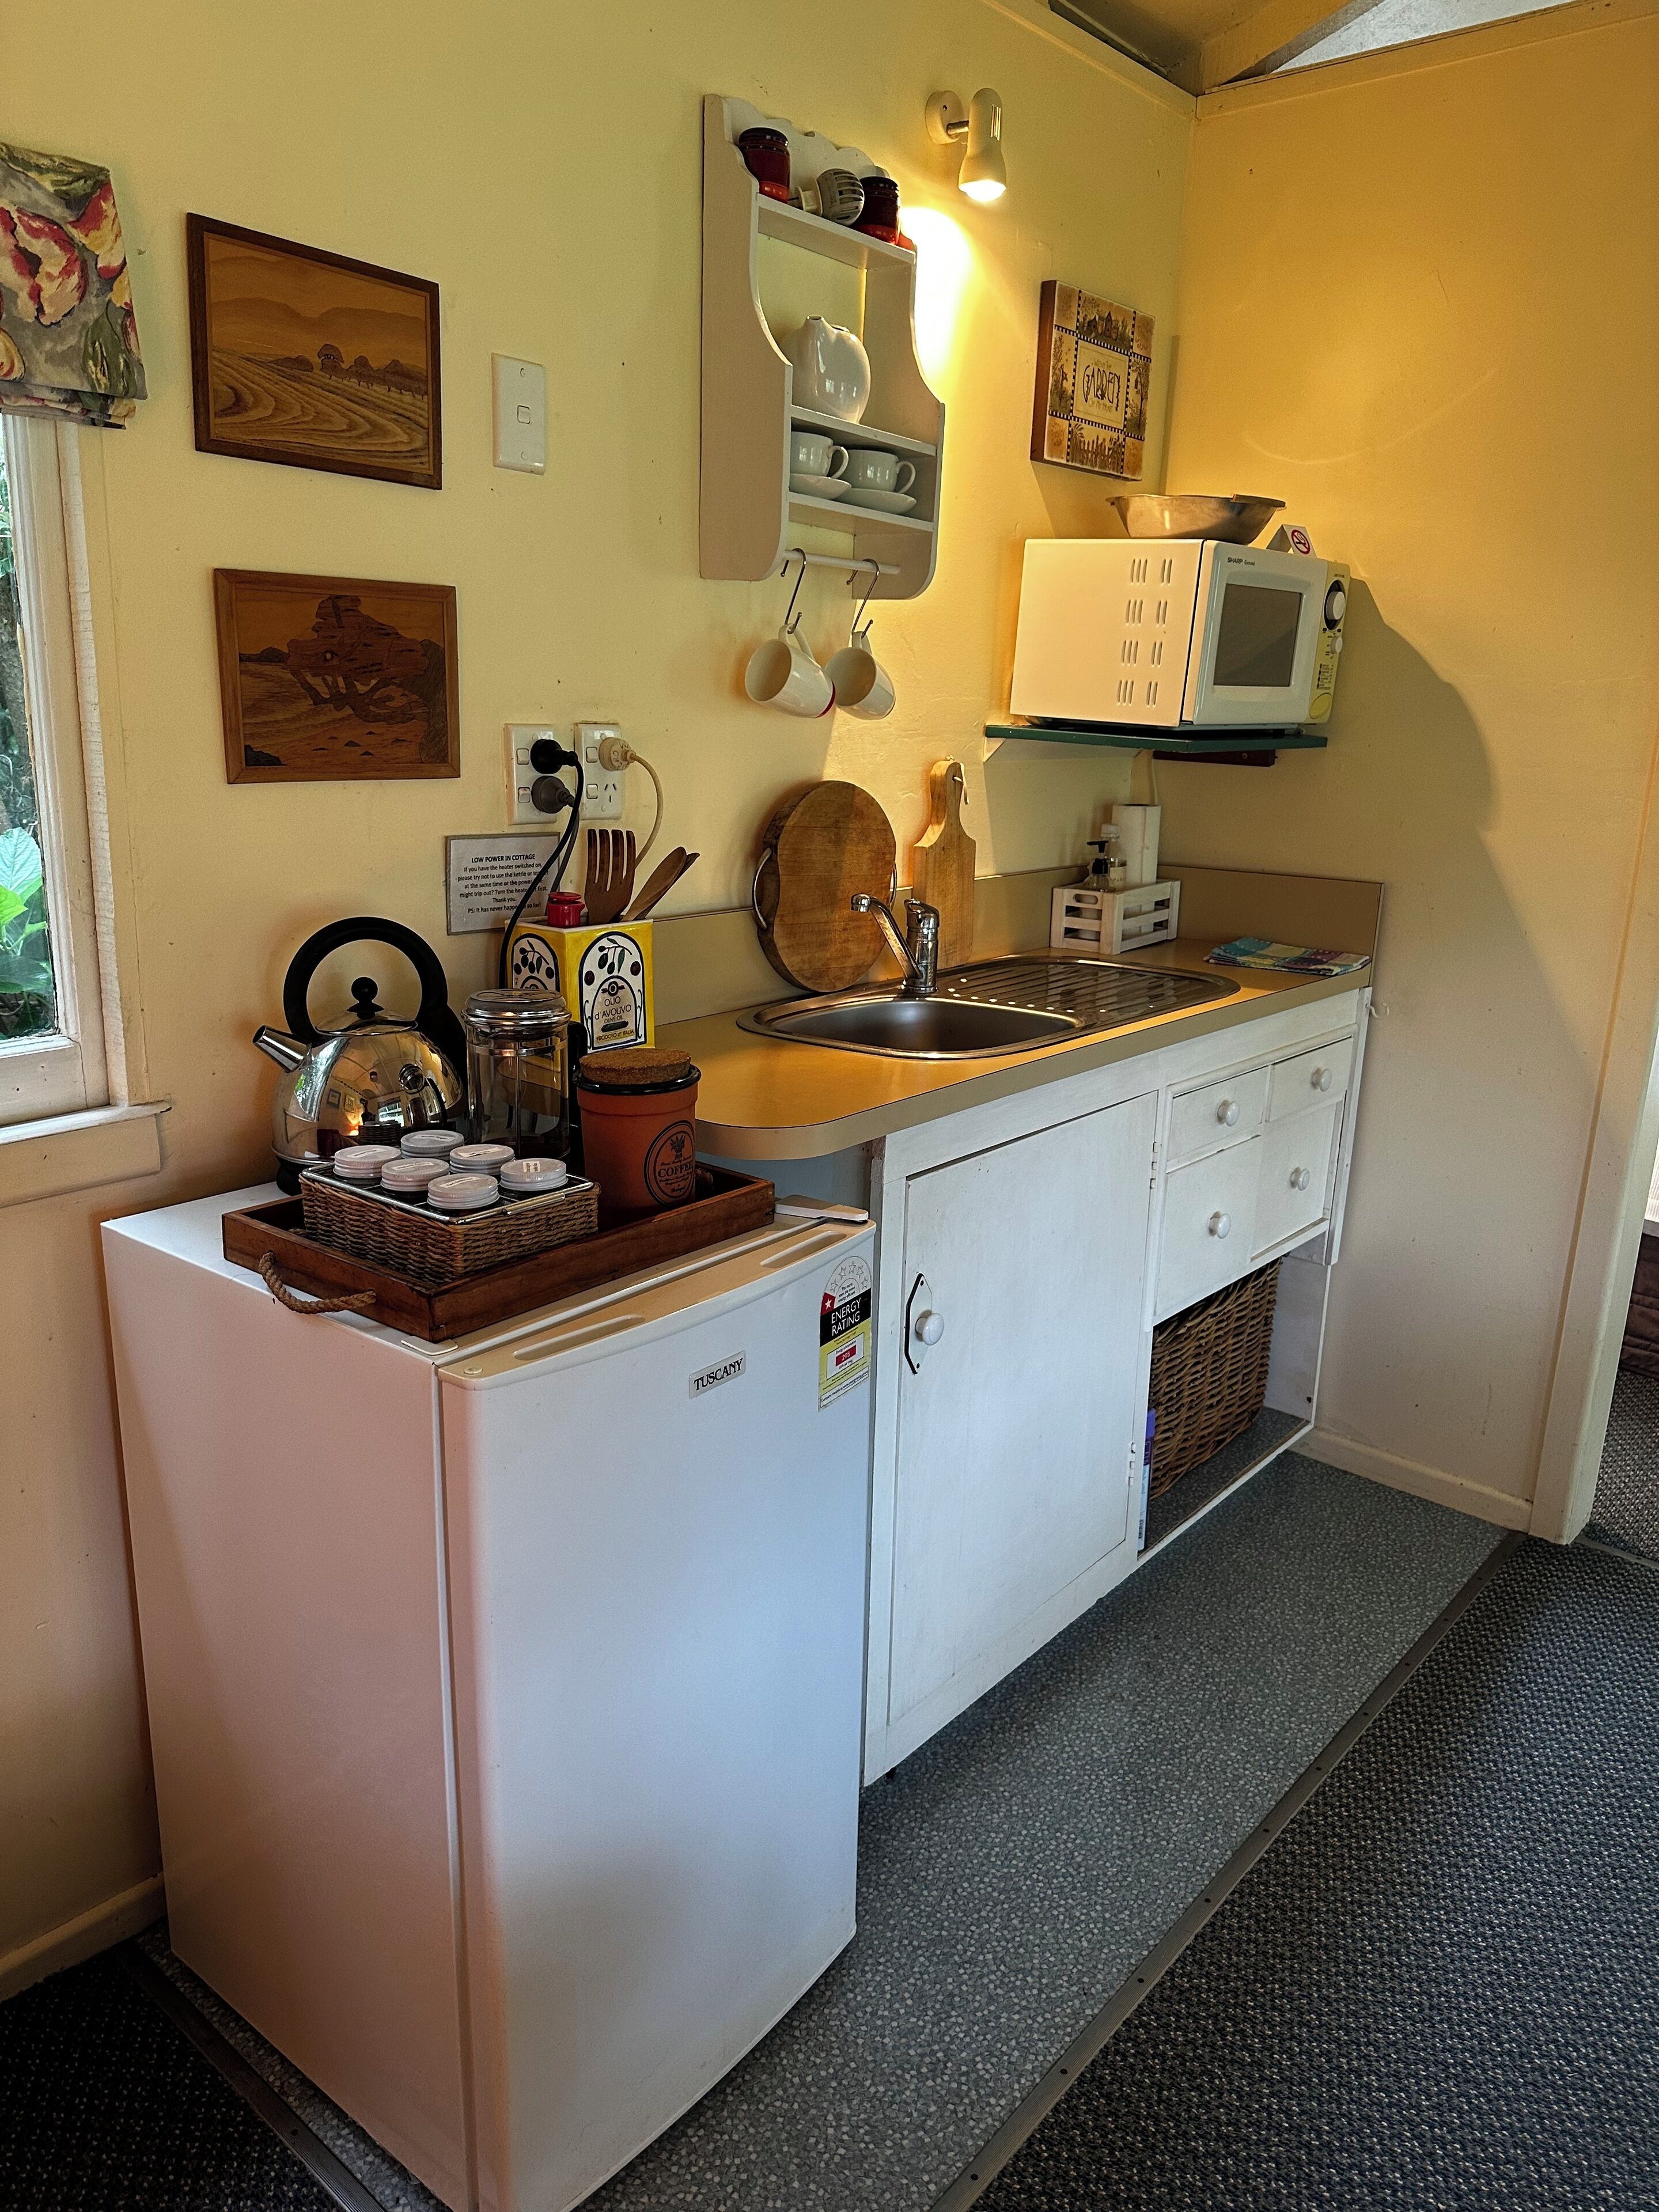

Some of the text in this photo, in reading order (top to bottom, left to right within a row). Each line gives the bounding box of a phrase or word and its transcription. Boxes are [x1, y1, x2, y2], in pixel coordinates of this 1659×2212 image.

[1083, 365, 1120, 411] GARDEN
[604, 996, 621, 1006] OLIO
[658, 1160, 692, 1178] COFFEE
[831, 1297, 861, 1324] ENERGY
[832, 1311, 860, 1336] RATING
[694, 1358, 743, 1391] TUSCANY
